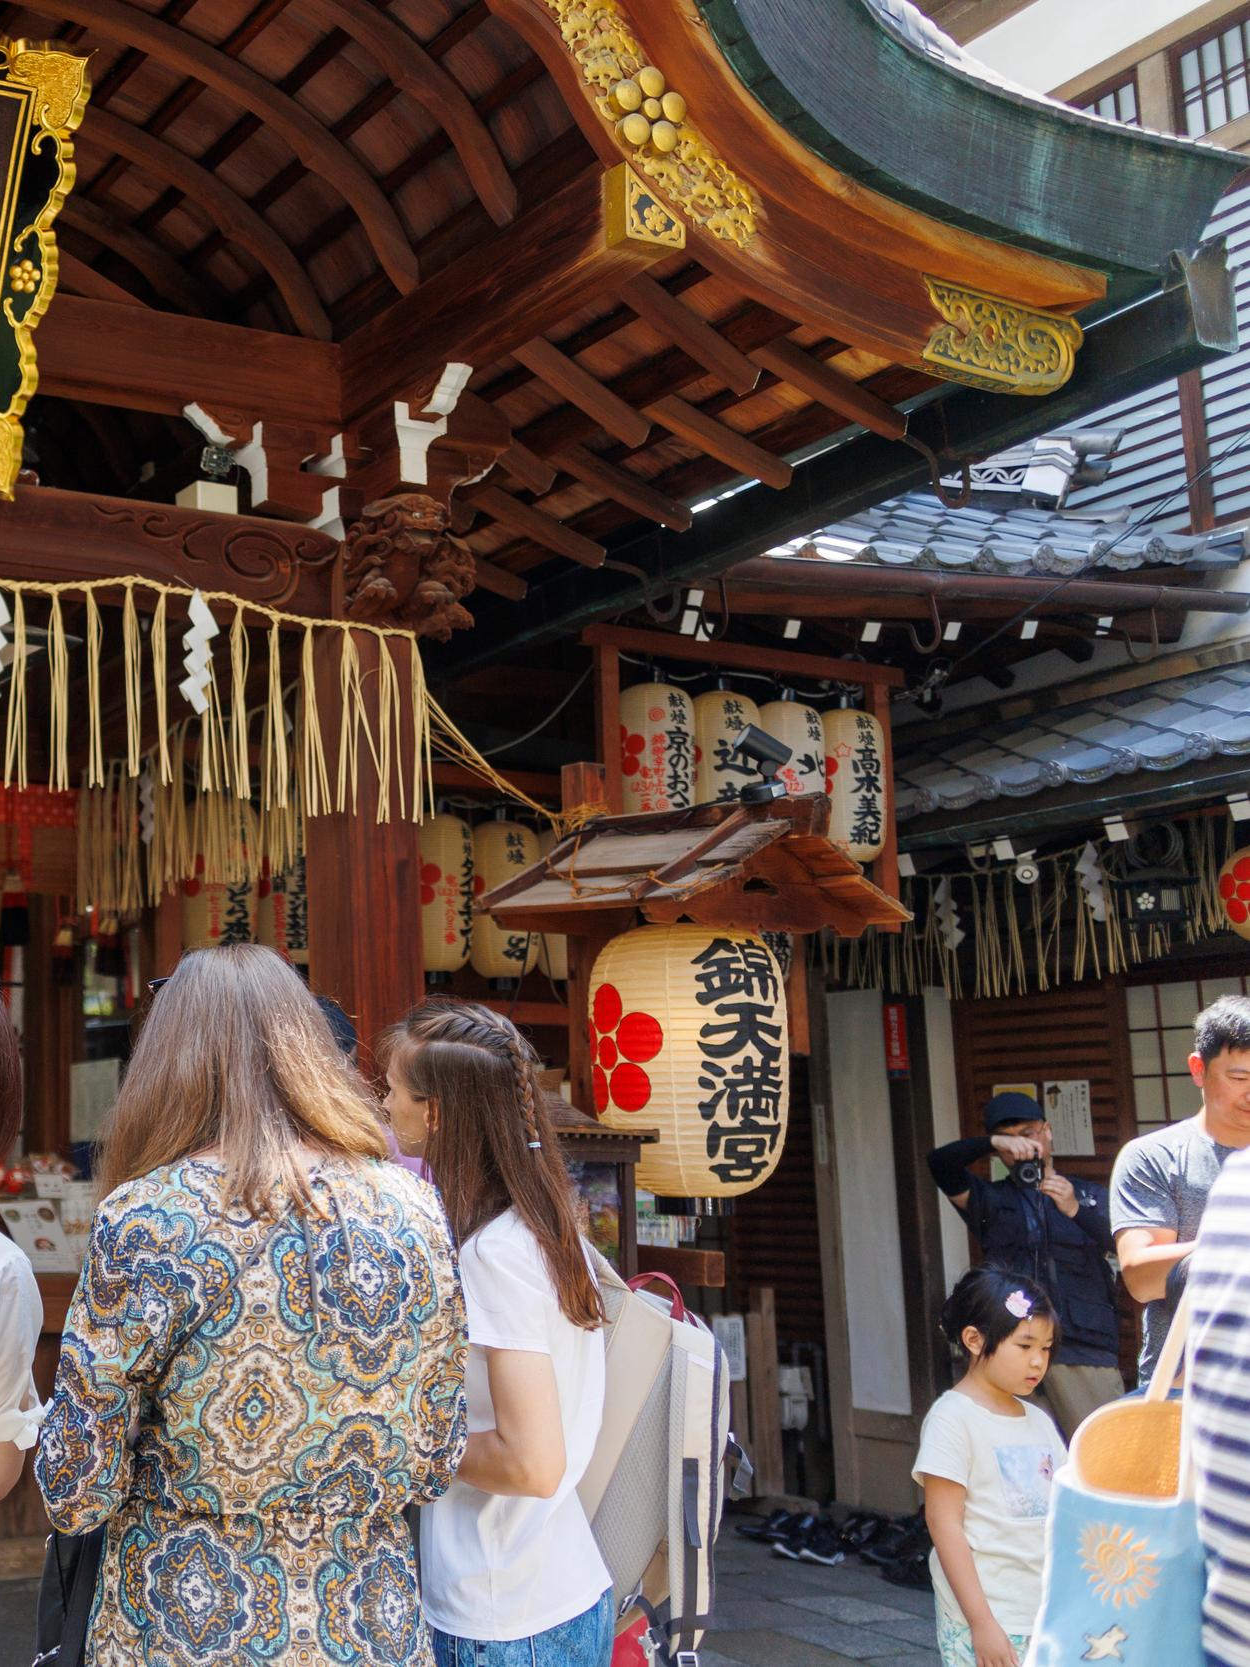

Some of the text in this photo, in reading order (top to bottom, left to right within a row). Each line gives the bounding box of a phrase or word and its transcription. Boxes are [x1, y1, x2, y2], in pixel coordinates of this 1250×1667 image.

[664, 726, 691, 809] 京のおへ
[690, 937, 784, 1184] 錦天満宮
